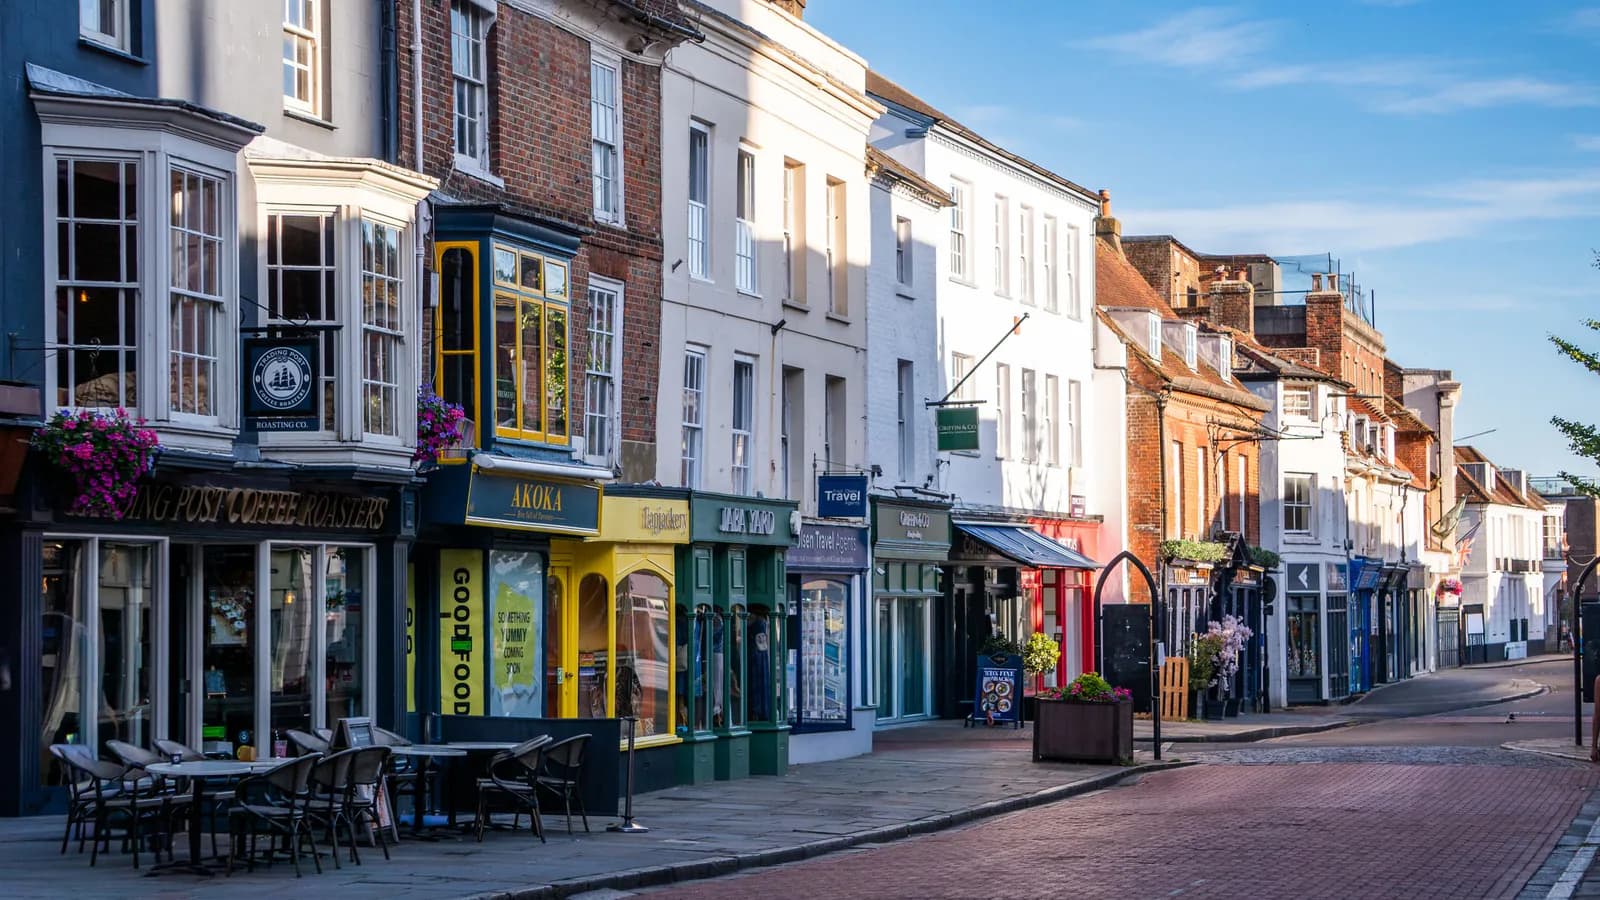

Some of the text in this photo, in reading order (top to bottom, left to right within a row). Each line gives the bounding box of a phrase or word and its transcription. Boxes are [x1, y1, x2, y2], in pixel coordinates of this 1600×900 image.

[259, 350, 306, 367] TRADING POST
[259, 389, 278, 406] COFFEE
[256, 421, 294, 429] ROASTING
[511, 483, 562, 512] AKOKA
[824, 490, 861, 501] Travel
[171, 485, 227, 523] POST
[228, 487, 301, 525] COFFEE
[302, 493, 389, 530] ROASTERS
[749, 509, 775, 535] YARD
[815, 530, 835, 549] Travel
[836, 532, 857, 554] Agents
[497, 611, 531, 624] SOMETHING
[454, 567, 470, 715] GOOD FOOD
[500, 628, 528, 642] YUMMY
[503, 647, 524, 658] COMING
[506, 662, 521, 674] SOON
